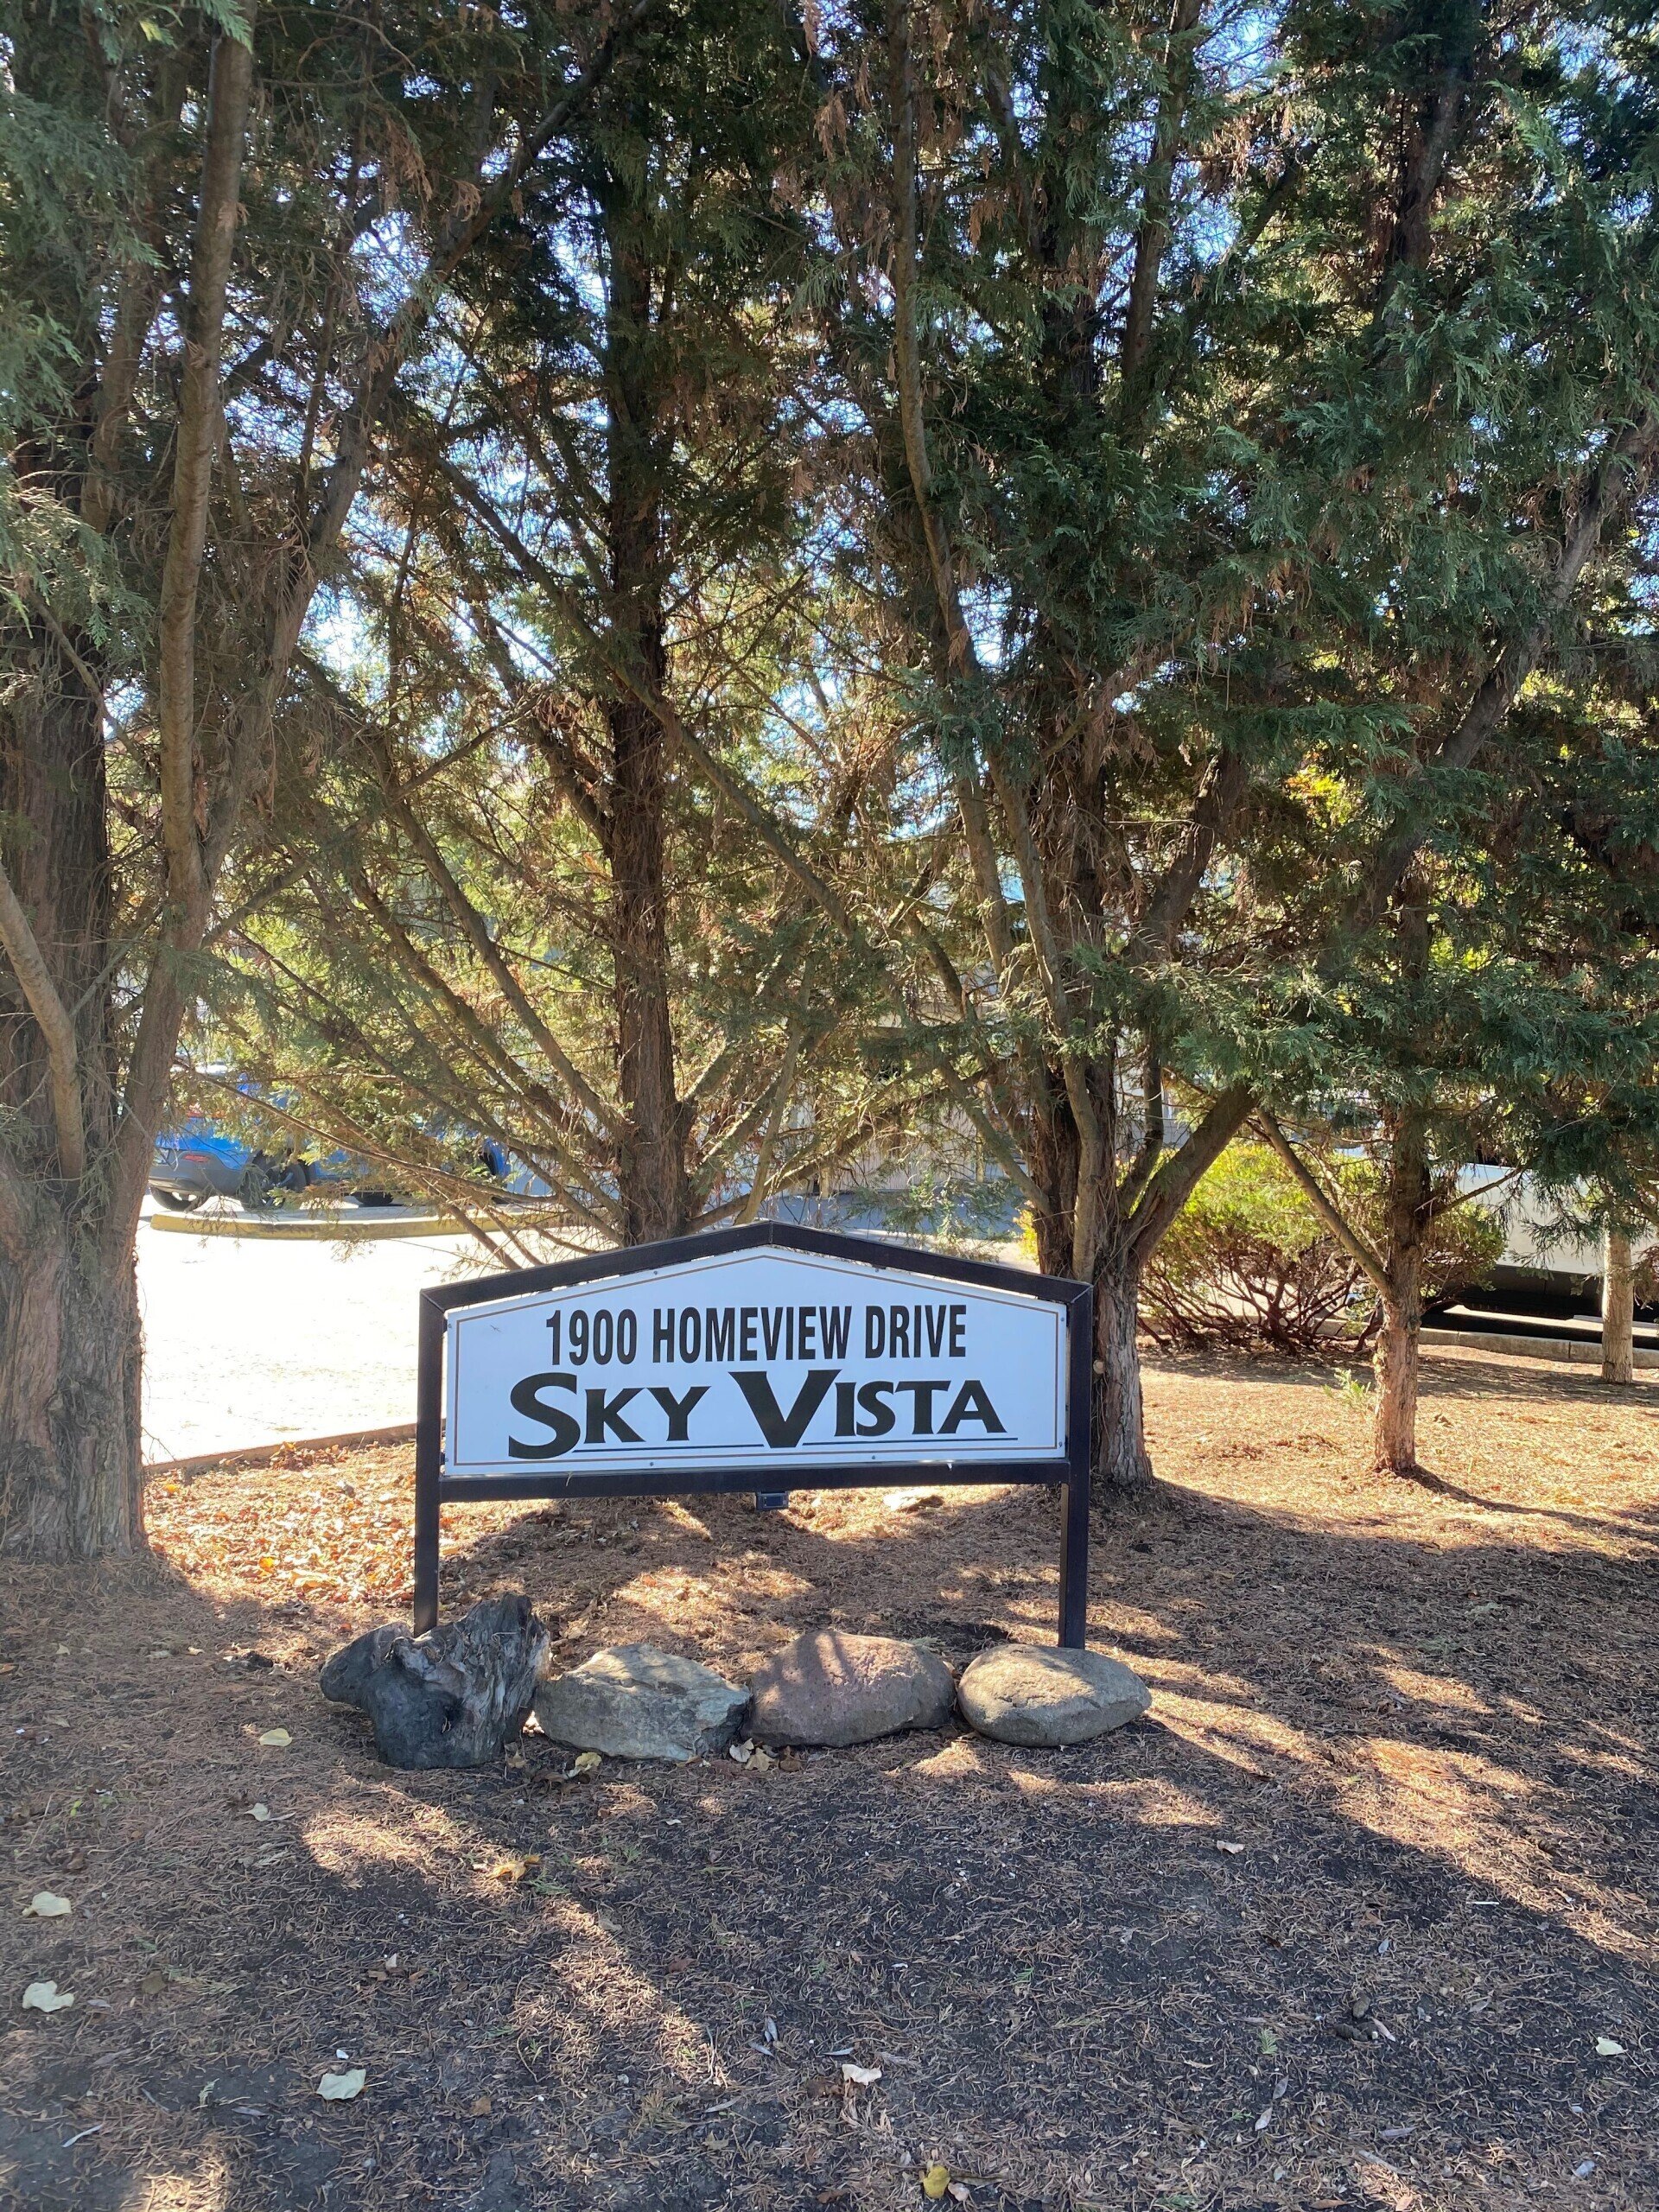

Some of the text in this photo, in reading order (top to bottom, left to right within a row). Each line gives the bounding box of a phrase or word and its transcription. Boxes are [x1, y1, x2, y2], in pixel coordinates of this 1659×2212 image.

[546, 1304, 967, 1366] 1900 HOMEVIEW DRIVE
[508, 1369, 1007, 1459] SKY VISTA
